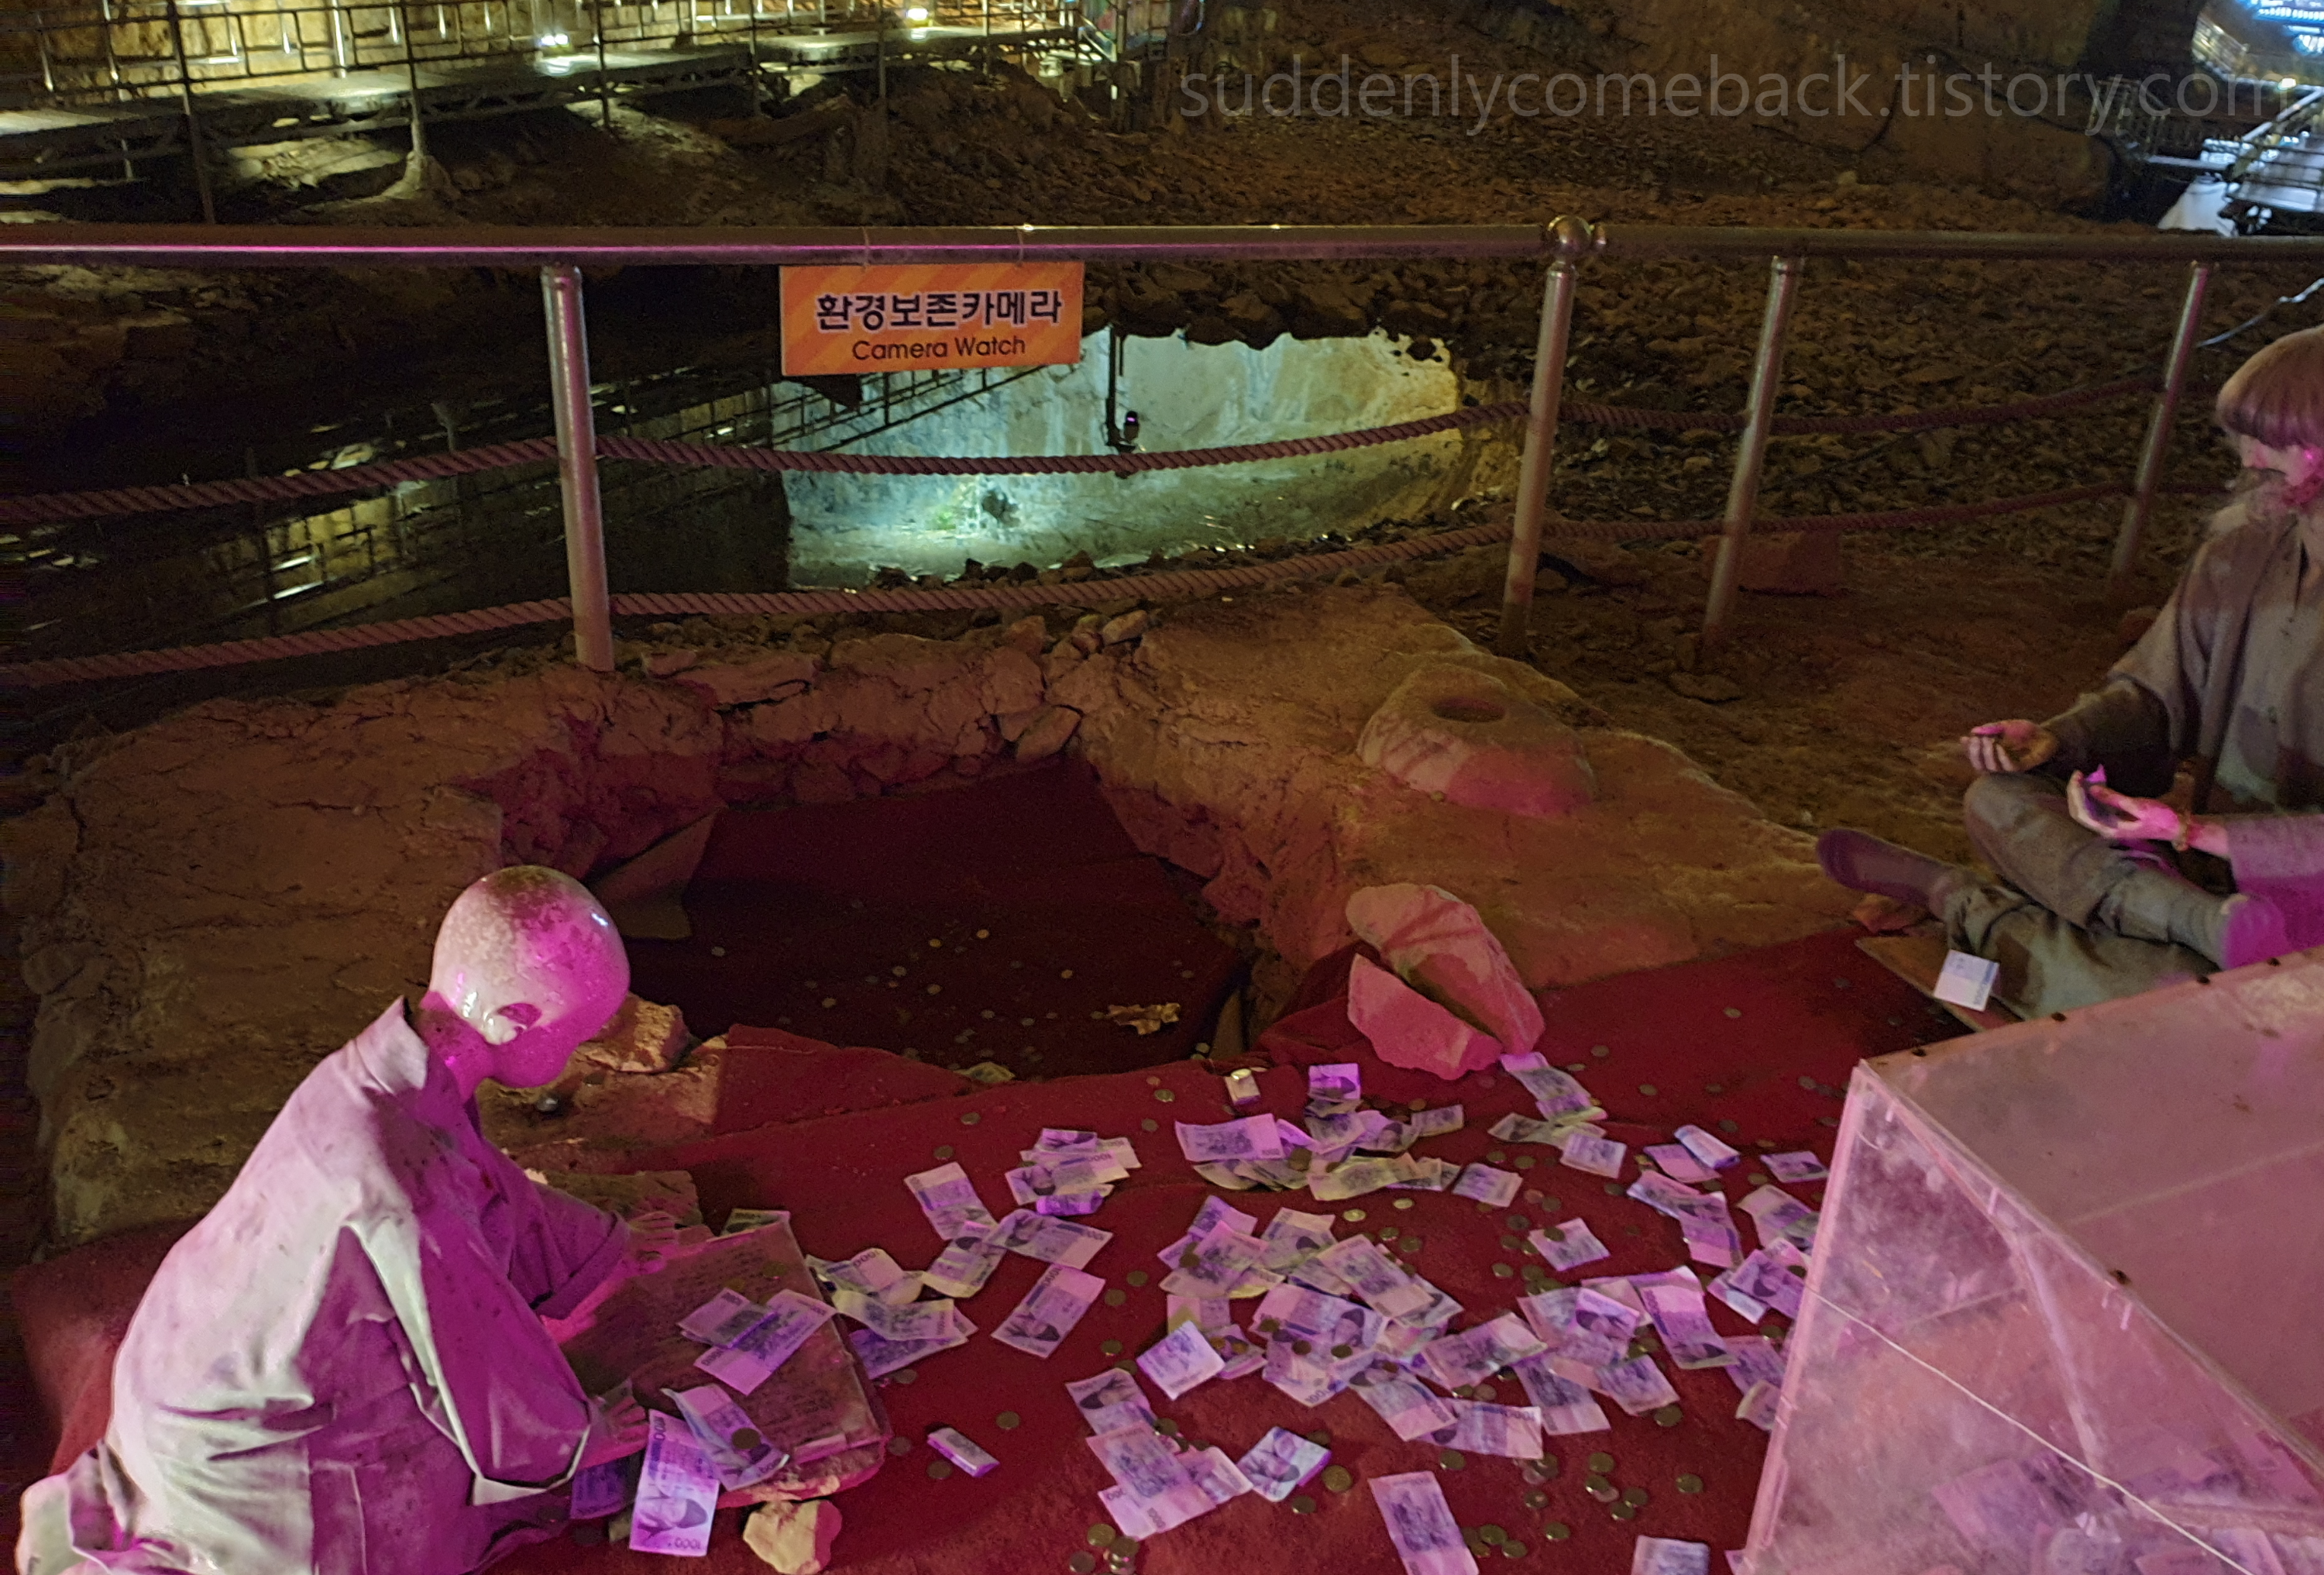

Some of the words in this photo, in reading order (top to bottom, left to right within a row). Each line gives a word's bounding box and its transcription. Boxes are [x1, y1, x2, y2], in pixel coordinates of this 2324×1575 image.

[816, 290, 1063, 331] 환경보존카메라
[852, 340, 947, 360] Camera
[955, 335, 1025, 356] Watch
